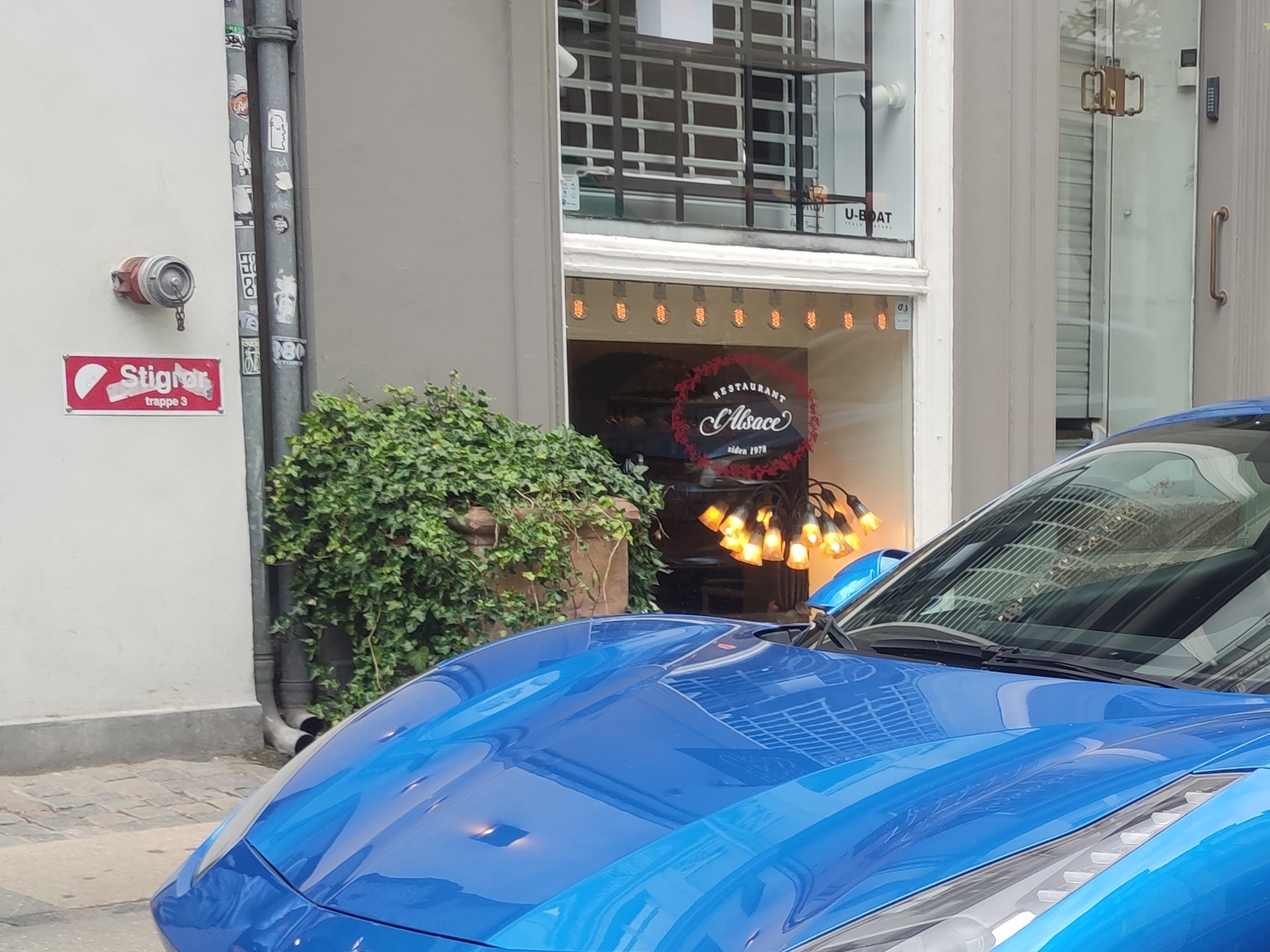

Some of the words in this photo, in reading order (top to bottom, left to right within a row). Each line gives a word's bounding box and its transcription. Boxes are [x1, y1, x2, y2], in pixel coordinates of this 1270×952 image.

[845, 208, 892, 223] U-BOAT
[713, 382, 786, 403] RESTAURANT
[145, 396, 179, 409] trappe
[181, 397, 188, 407] 3
[700, 404, 792, 436] l'Alsace
[727, 445, 747, 456] siden
[749, 445, 767, 455] 1978
